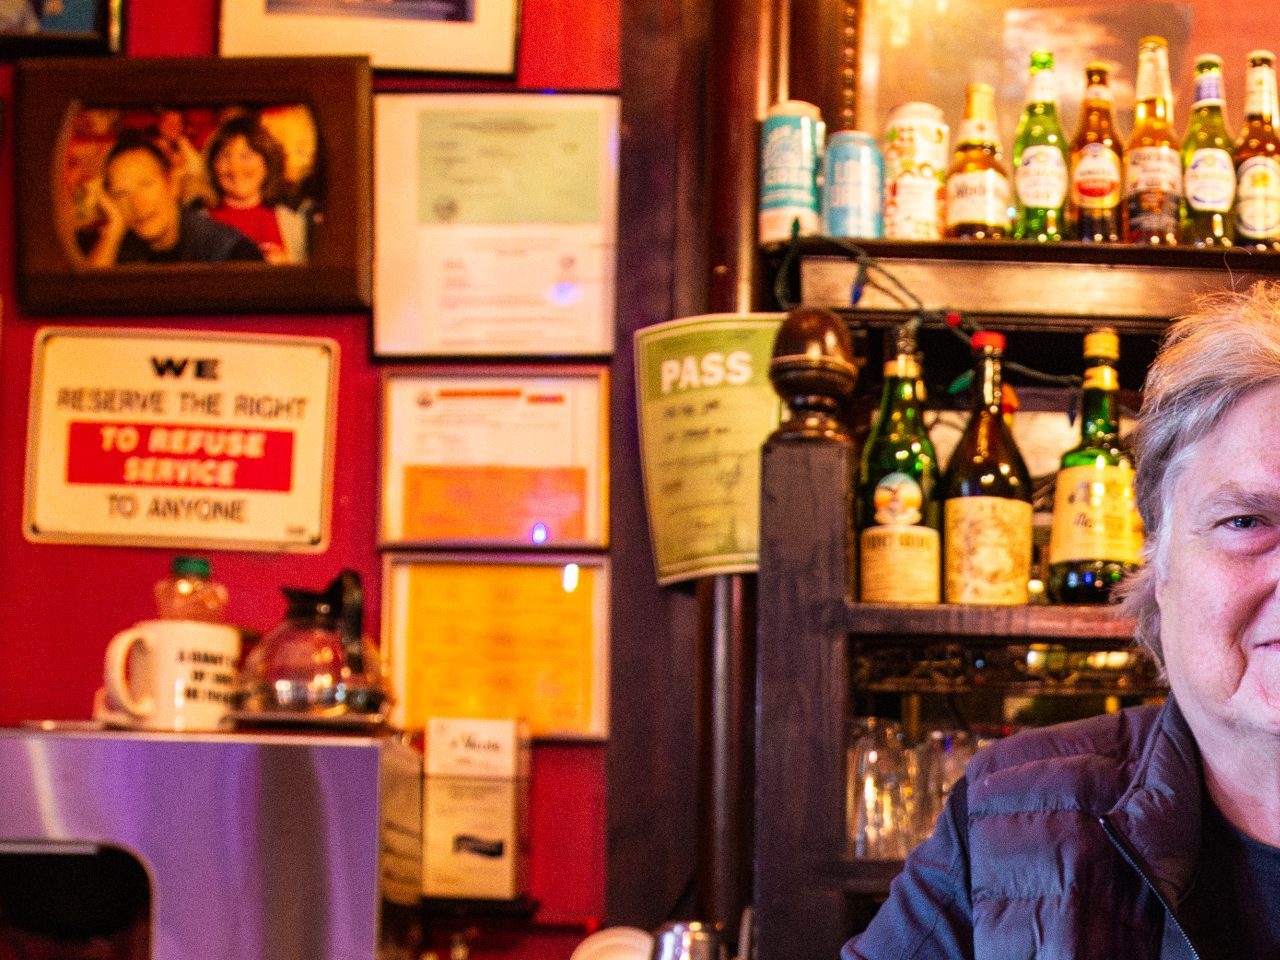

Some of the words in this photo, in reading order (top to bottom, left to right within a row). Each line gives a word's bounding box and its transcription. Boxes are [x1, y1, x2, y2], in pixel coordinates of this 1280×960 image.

[151, 356, 219, 379] WE
[661, 350, 752, 394] PASS
[57, 387, 163, 413] RESERVE
[179, 391, 222, 417] THE
[234, 394, 307, 420] RIGHT
[101, 426, 140, 453] TO
[148, 427, 267, 458] REFUSE
[124, 456, 238, 487] SERVICE
[107, 493, 138, 519] TO
[147, 496, 246, 524] ANYONE
